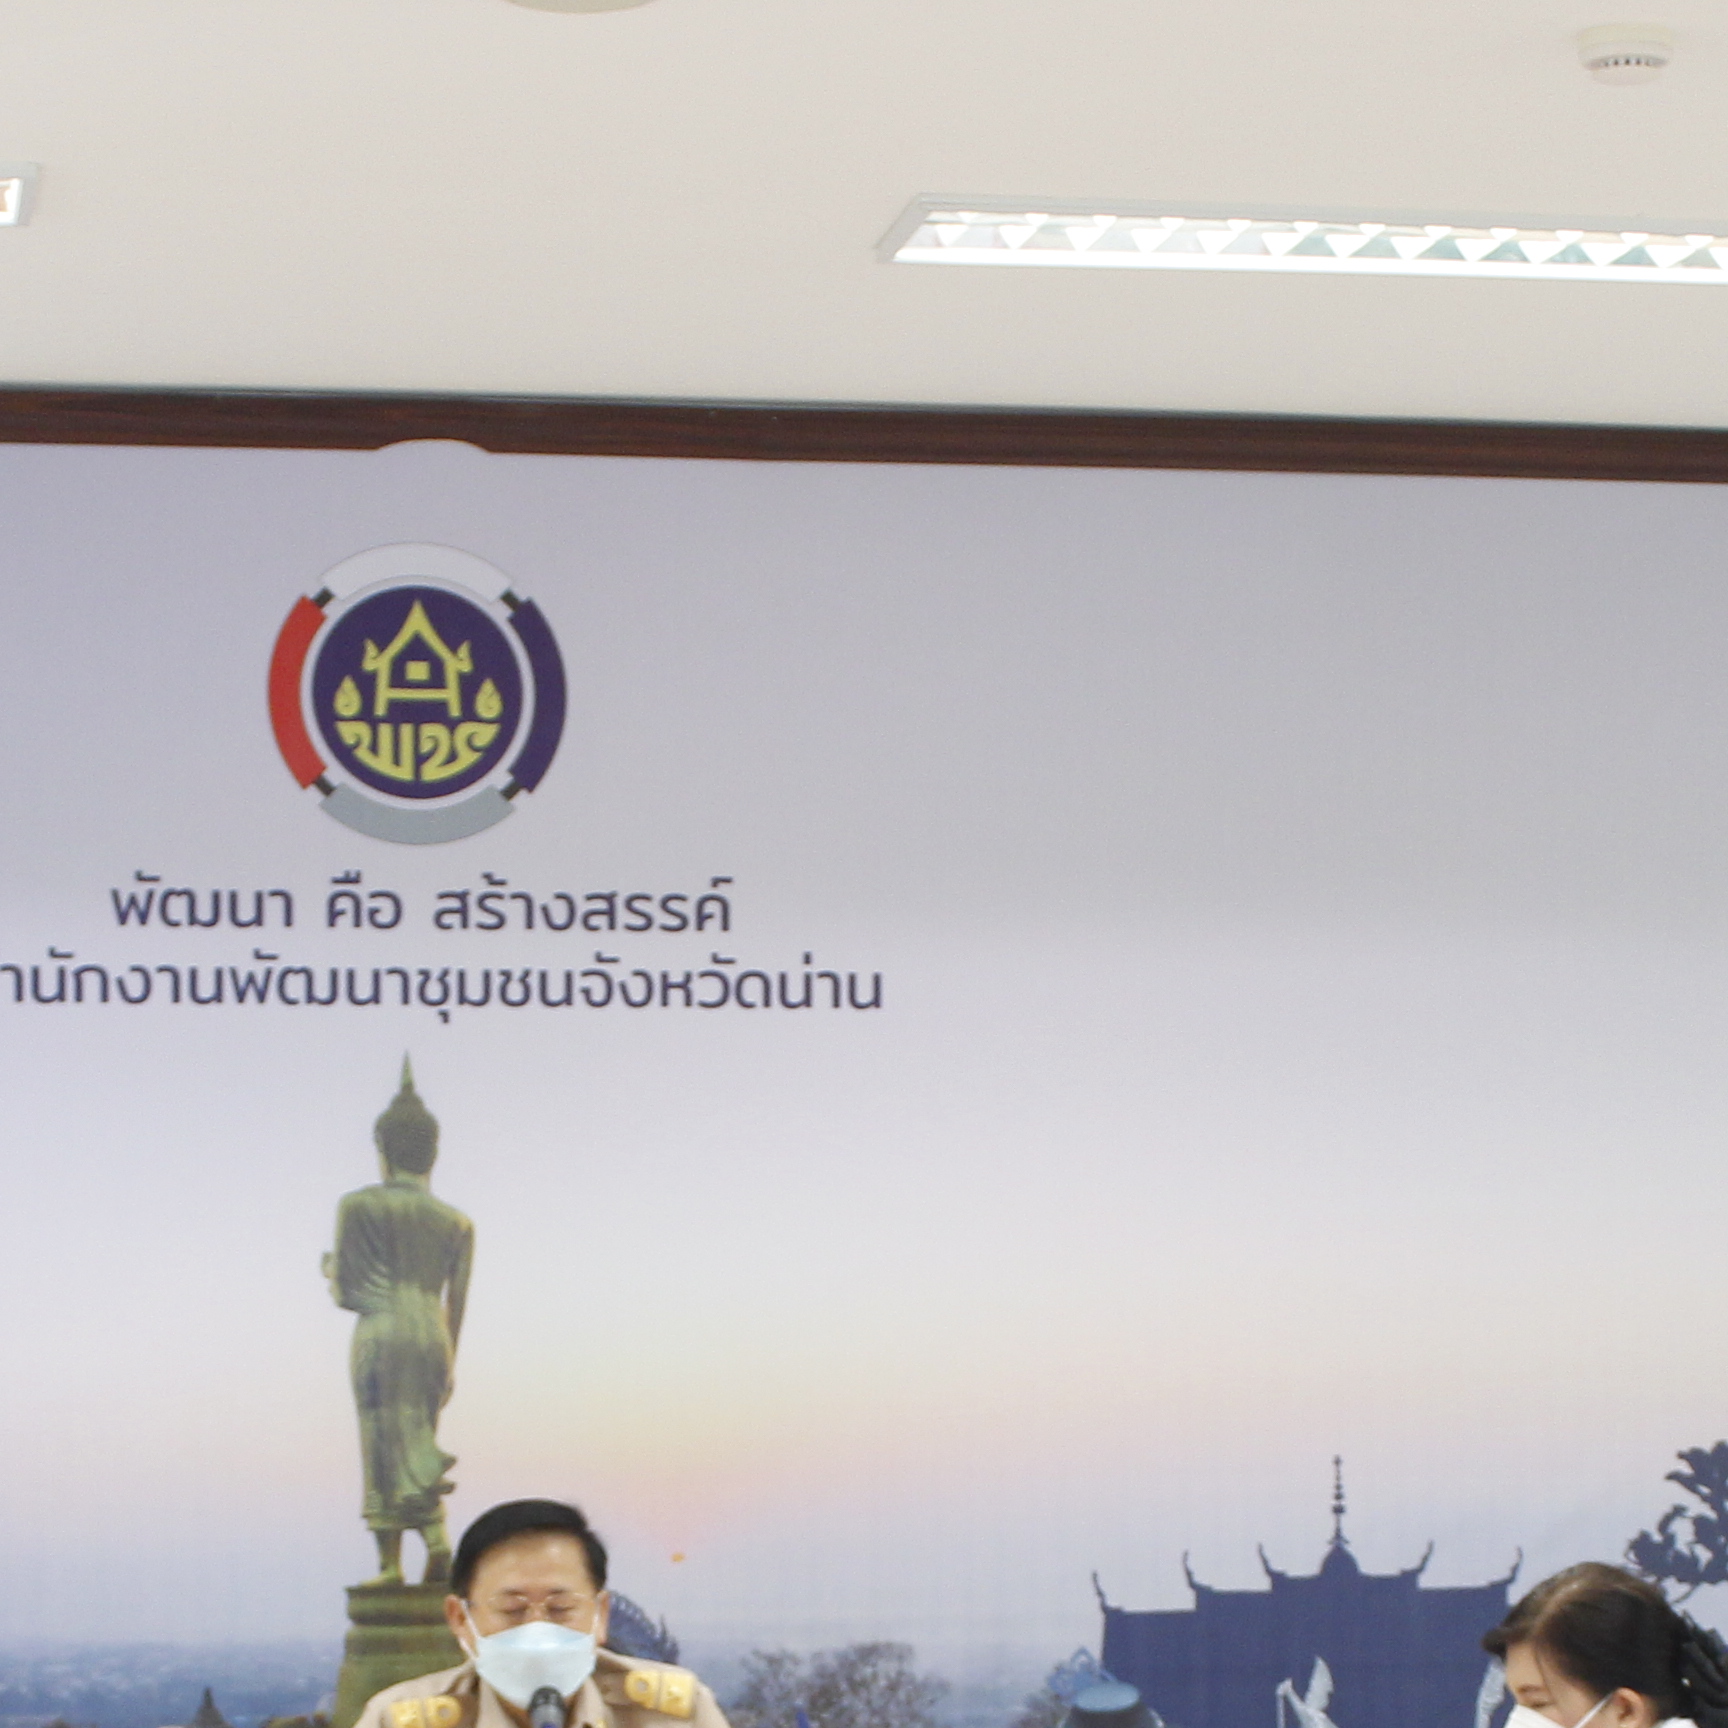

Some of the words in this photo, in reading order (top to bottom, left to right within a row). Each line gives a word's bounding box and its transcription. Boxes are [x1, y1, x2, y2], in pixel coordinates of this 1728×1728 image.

[110, 870, 295, 931] พัฒนา
[326, 868, 404, 931] คือ
[432, 872, 736, 934] สร้างสรรค์
